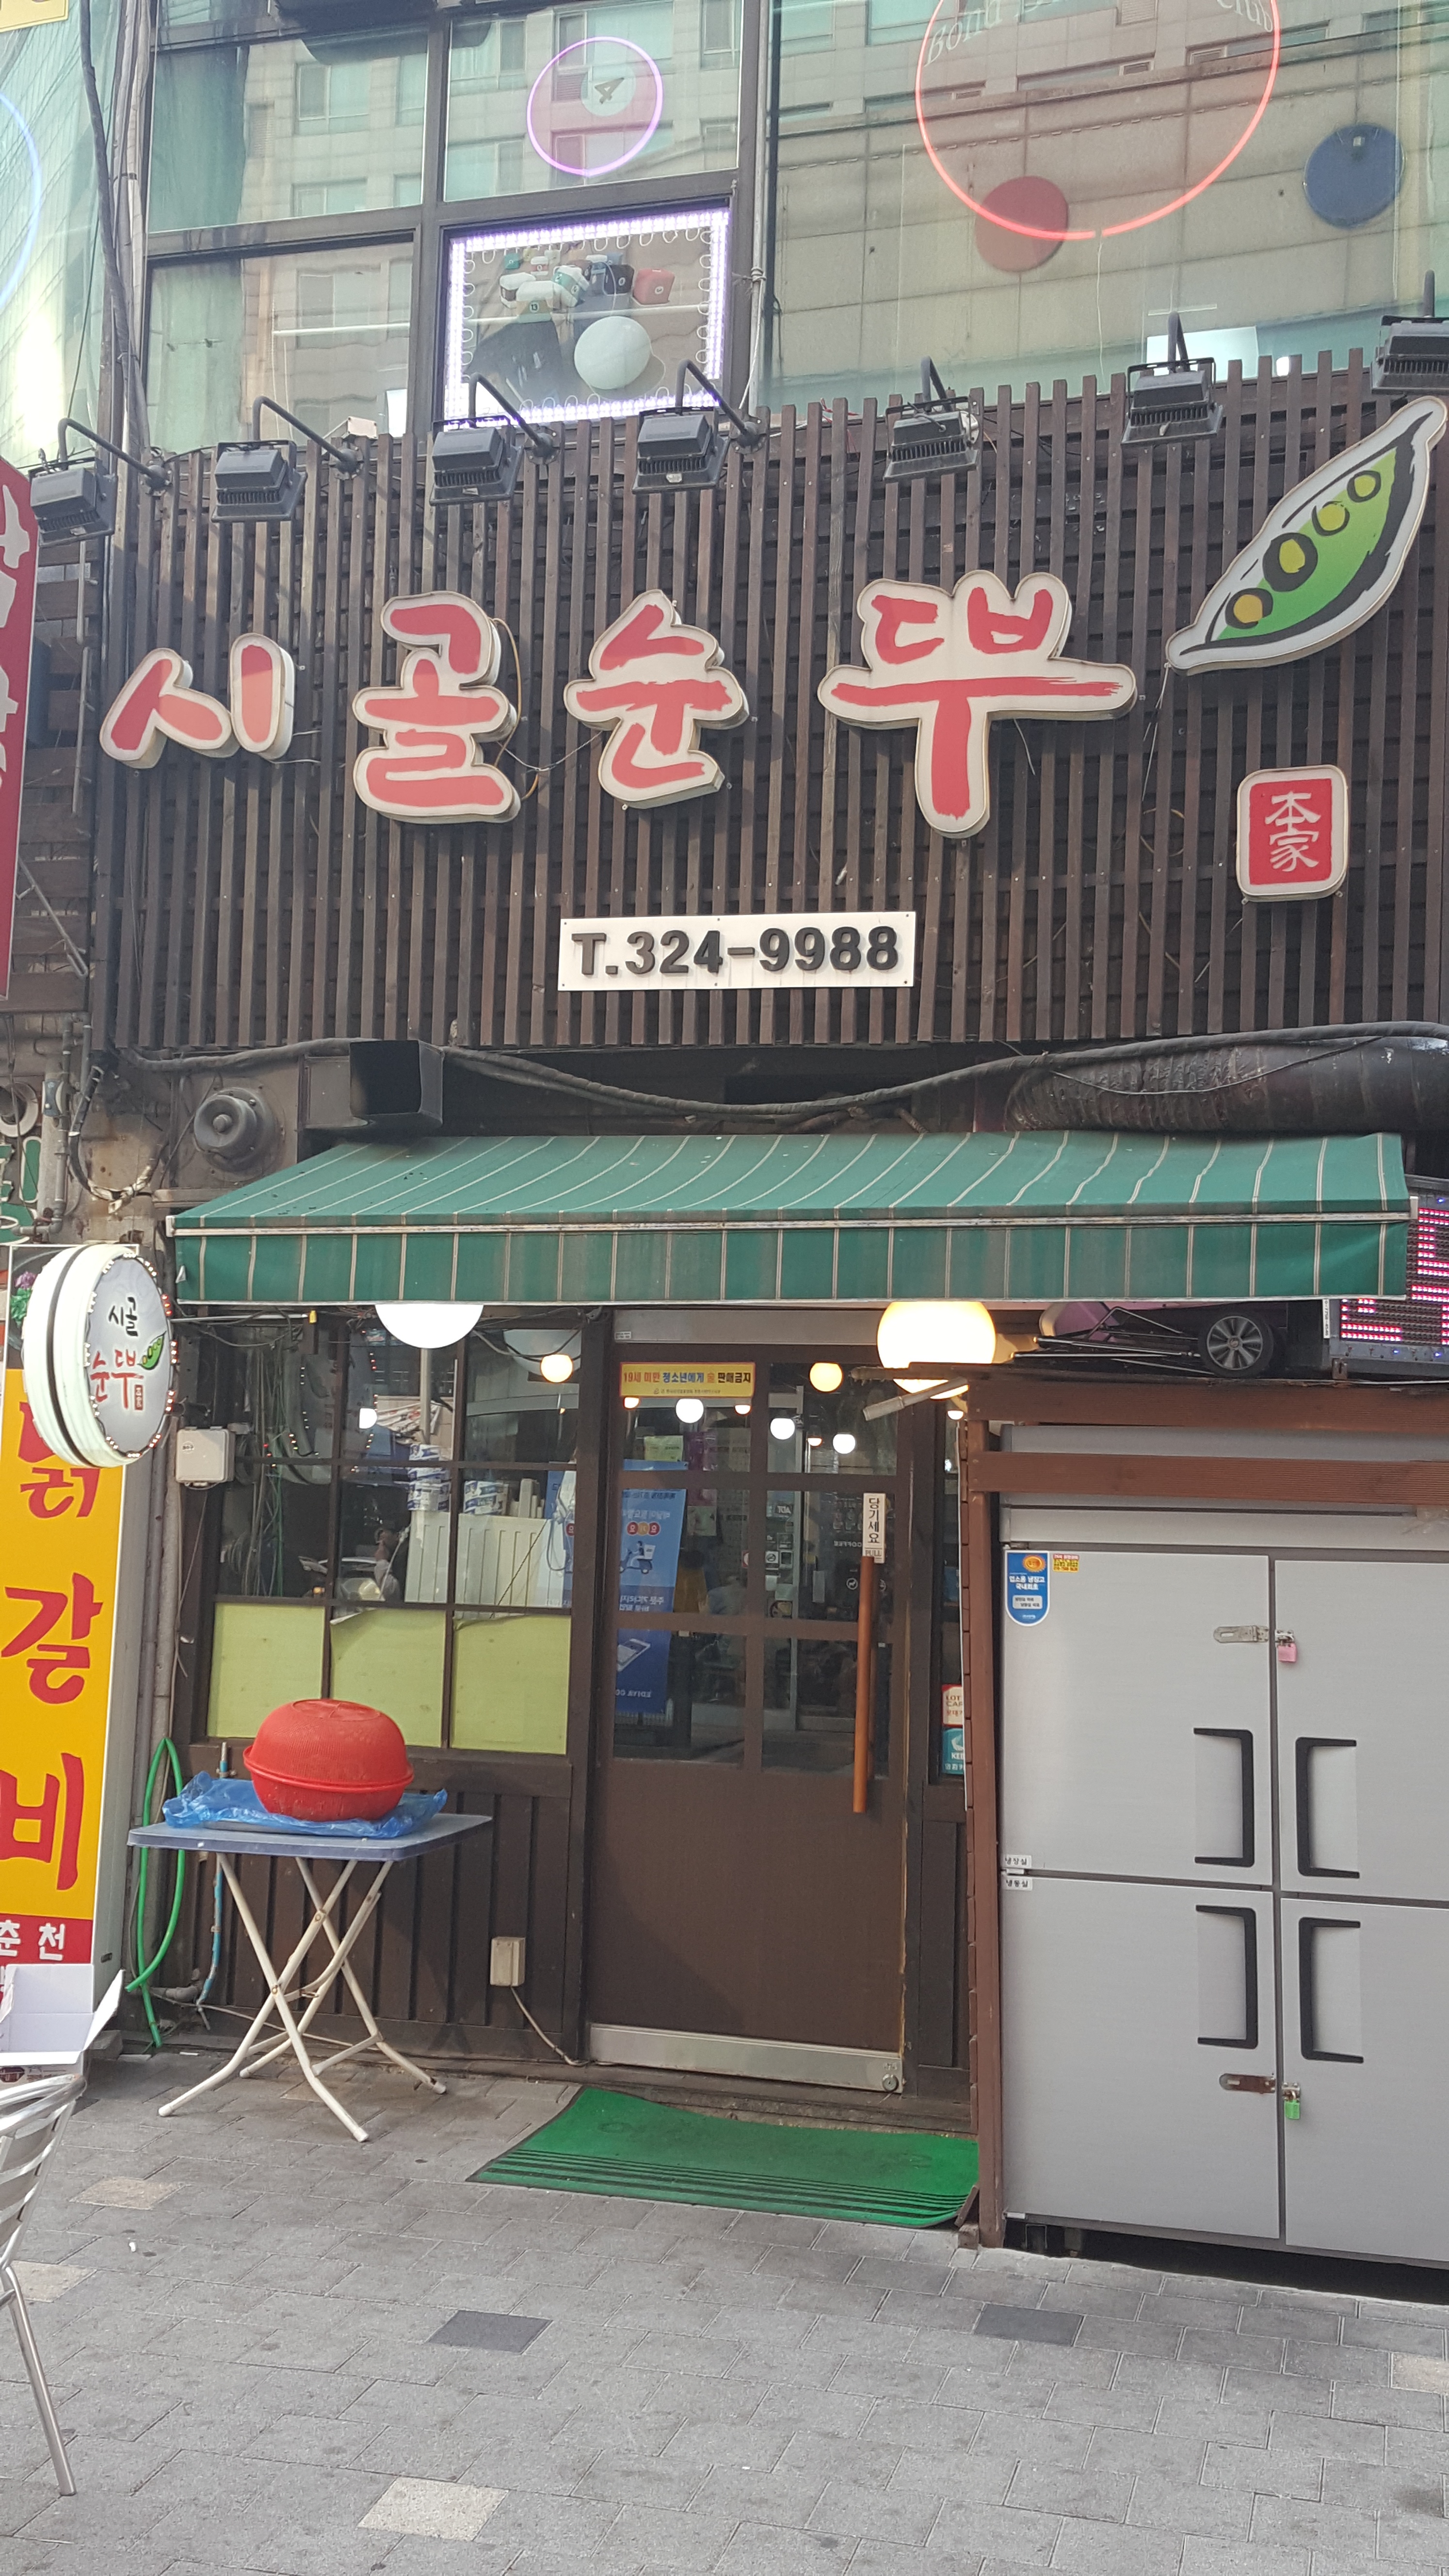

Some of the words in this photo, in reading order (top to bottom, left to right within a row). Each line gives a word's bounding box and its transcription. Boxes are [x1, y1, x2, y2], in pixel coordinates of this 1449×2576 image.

[1264, 790, 1321, 872] 本家
[571, 926, 899, 975] T.324-9988
[108, 1297, 138, 1336] 시골
[90, 1349, 144, 1409] 순두부
[624, 1372, 641, 1383] 19세
[644, 1372, 660, 1383] 미만
[662, 1372, 705, 1384] 청소년에게
[718, 1372, 751, 1384] 판매금지
[868, 1497, 880, 1543] 당기세요
